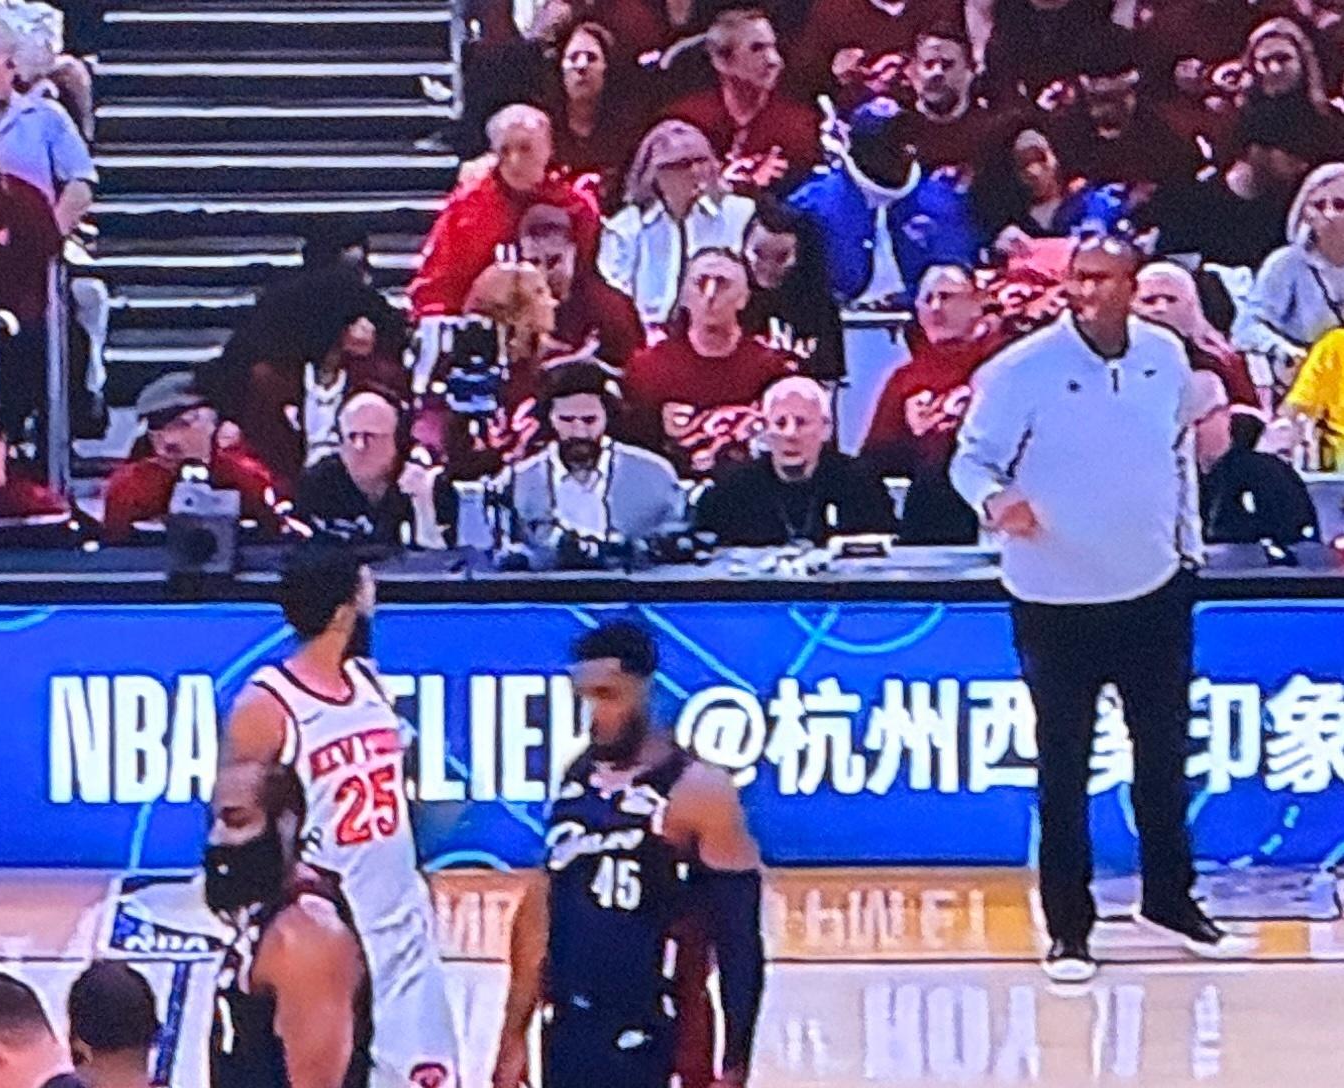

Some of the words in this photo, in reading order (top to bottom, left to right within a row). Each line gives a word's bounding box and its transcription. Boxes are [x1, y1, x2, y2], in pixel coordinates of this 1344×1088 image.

[49, 674, 218, 804] NBA
[334, 765, 399, 847] 25
[590, 855, 642, 911] 45
